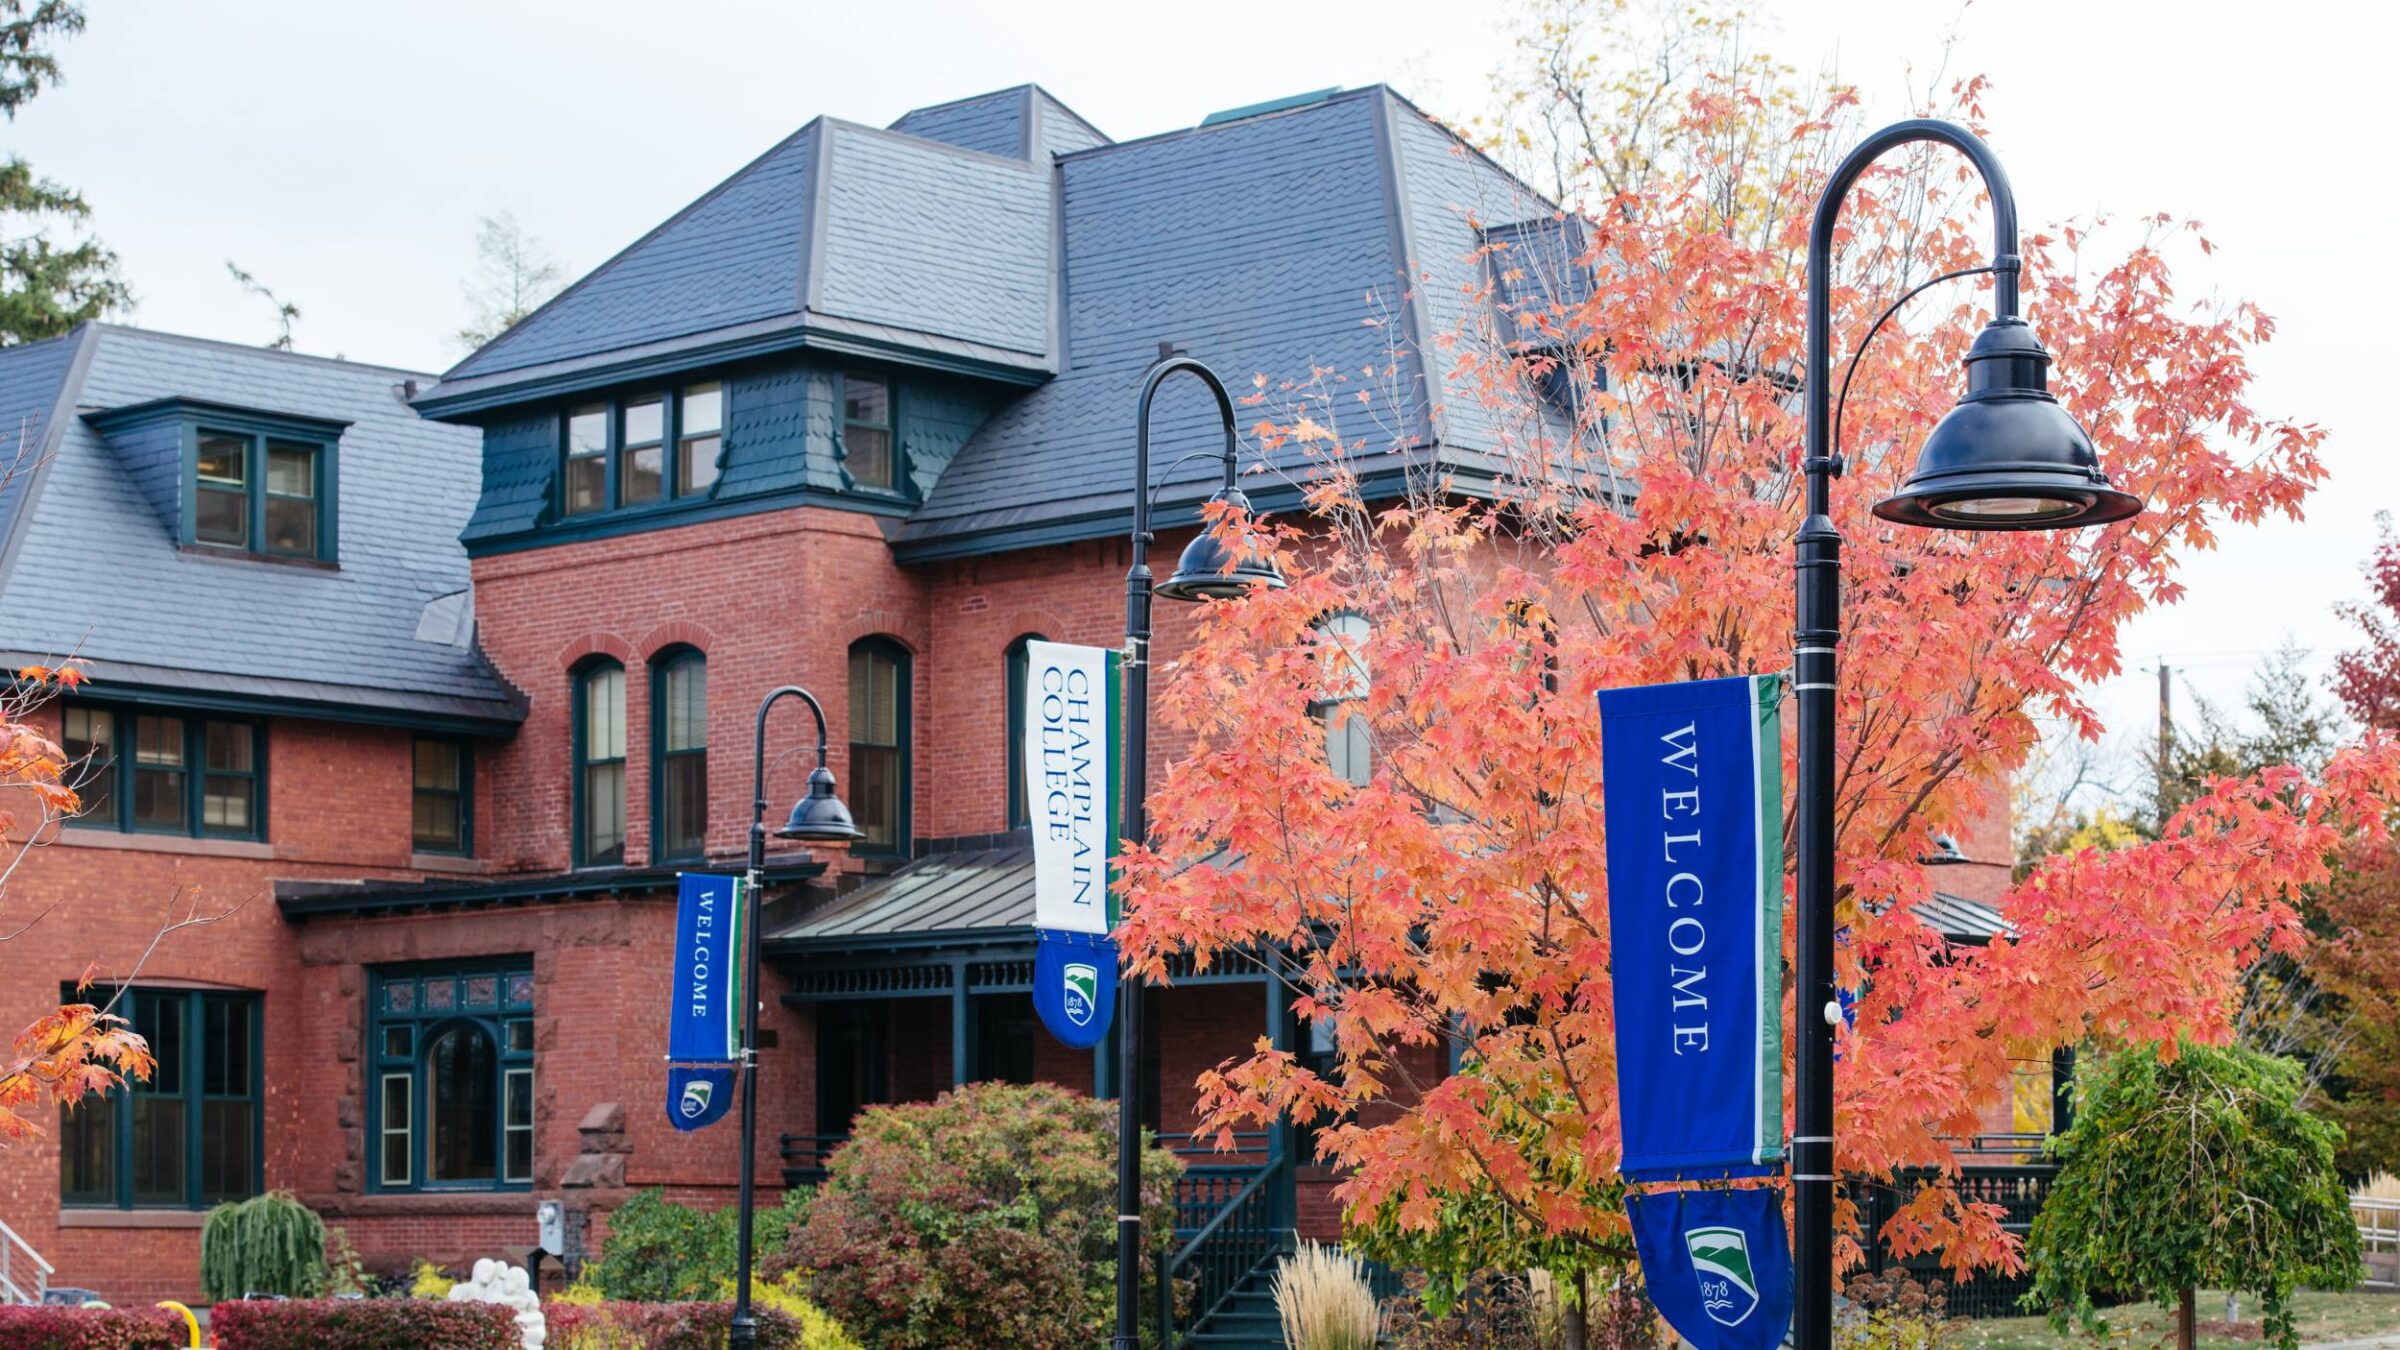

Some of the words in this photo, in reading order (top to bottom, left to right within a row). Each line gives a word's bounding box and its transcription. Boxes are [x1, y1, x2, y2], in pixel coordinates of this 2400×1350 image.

[1042, 666, 1070, 842] COLLEGE
[1067, 668, 1092, 907] CHAMPLAIN
[693, 891, 715, 1017] WELCOME
[1660, 721, 1709, 1056] WELCOME
[1067, 996, 1083, 1008] 1878
